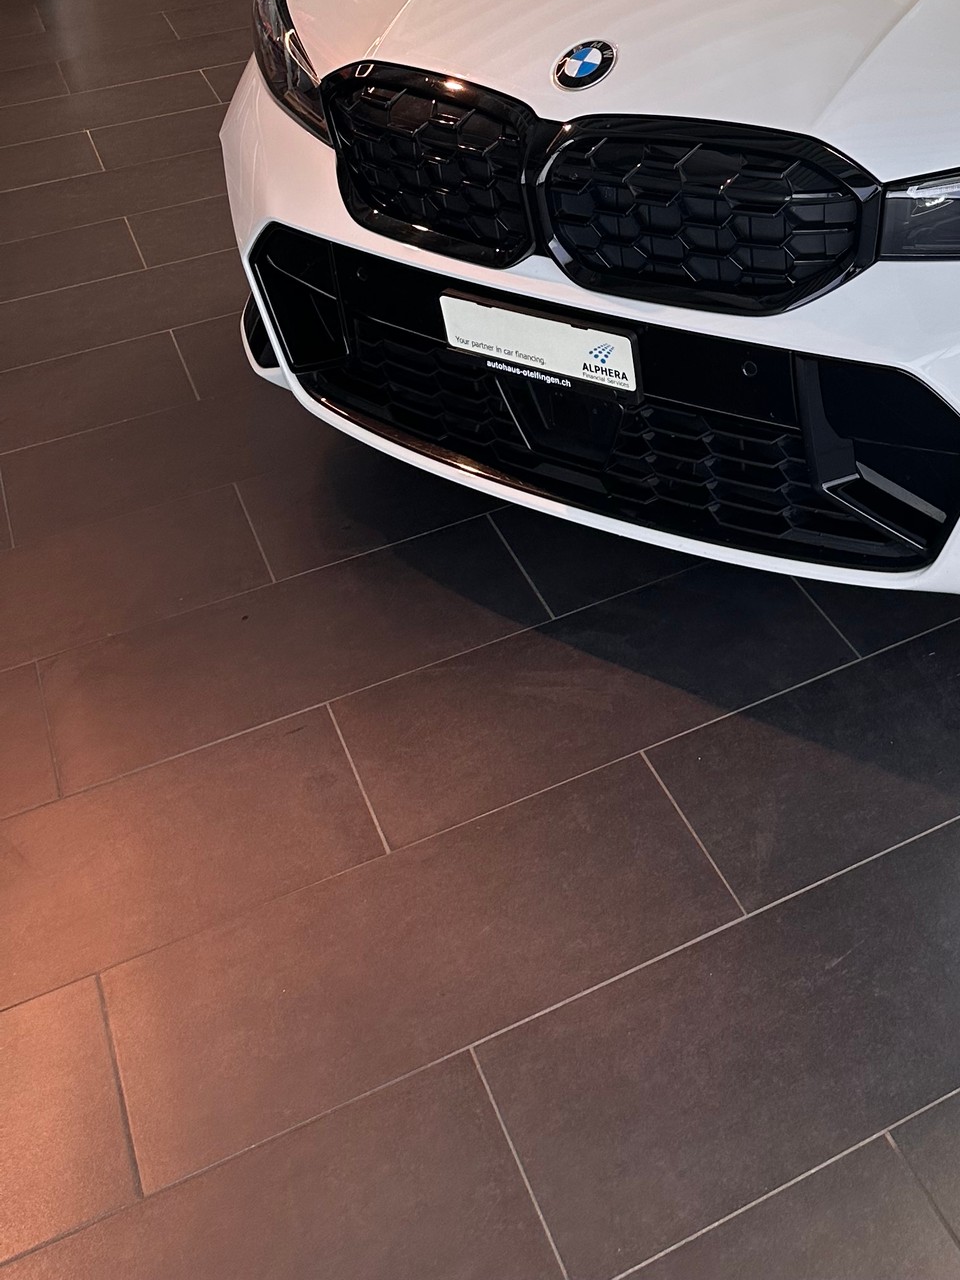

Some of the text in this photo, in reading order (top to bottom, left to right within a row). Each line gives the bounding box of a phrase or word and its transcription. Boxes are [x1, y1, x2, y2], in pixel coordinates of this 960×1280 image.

[455, 335, 470, 345] Your
[472, 340, 494, 351] partner
[496, 345, 502, 353] in
[582, 362, 629, 382] ALPHERA
[582, 371, 630, 389] Financial Services
